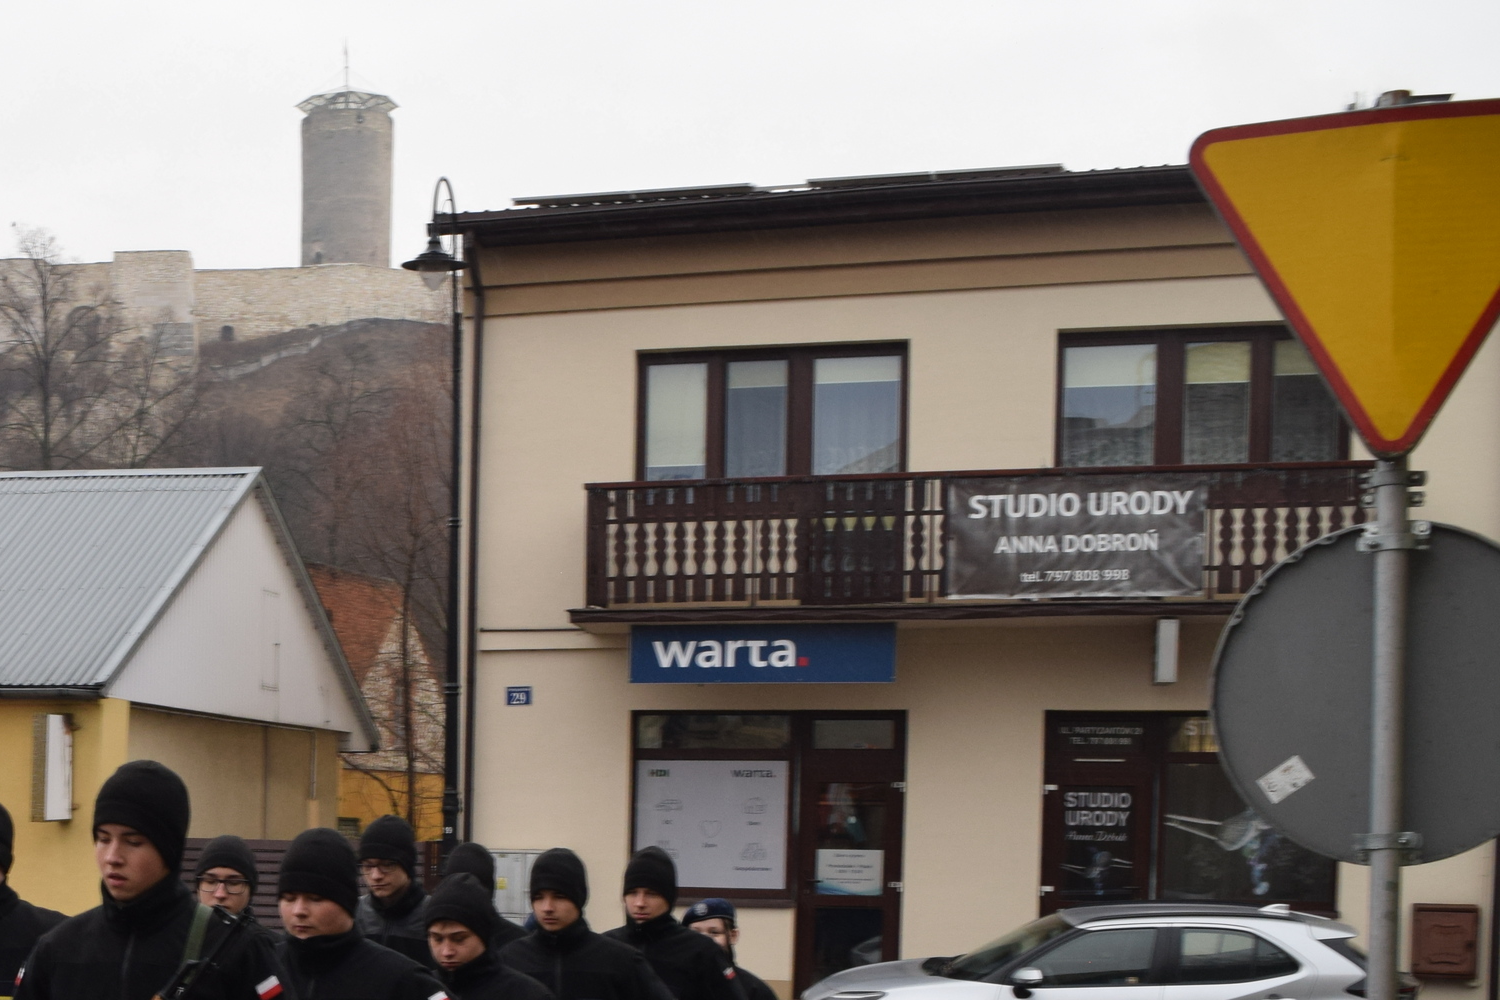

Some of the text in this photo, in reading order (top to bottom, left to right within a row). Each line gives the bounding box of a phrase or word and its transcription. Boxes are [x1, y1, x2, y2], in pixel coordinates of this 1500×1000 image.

[968, 490, 1194, 519] STUDIO URODY
[993, 528, 1159, 554] ANNA DOBROŃ
[1043, 570, 1071, 582] 797
[1063, 792, 1132, 808] STUDIO
[1064, 810, 1131, 827] URODY
